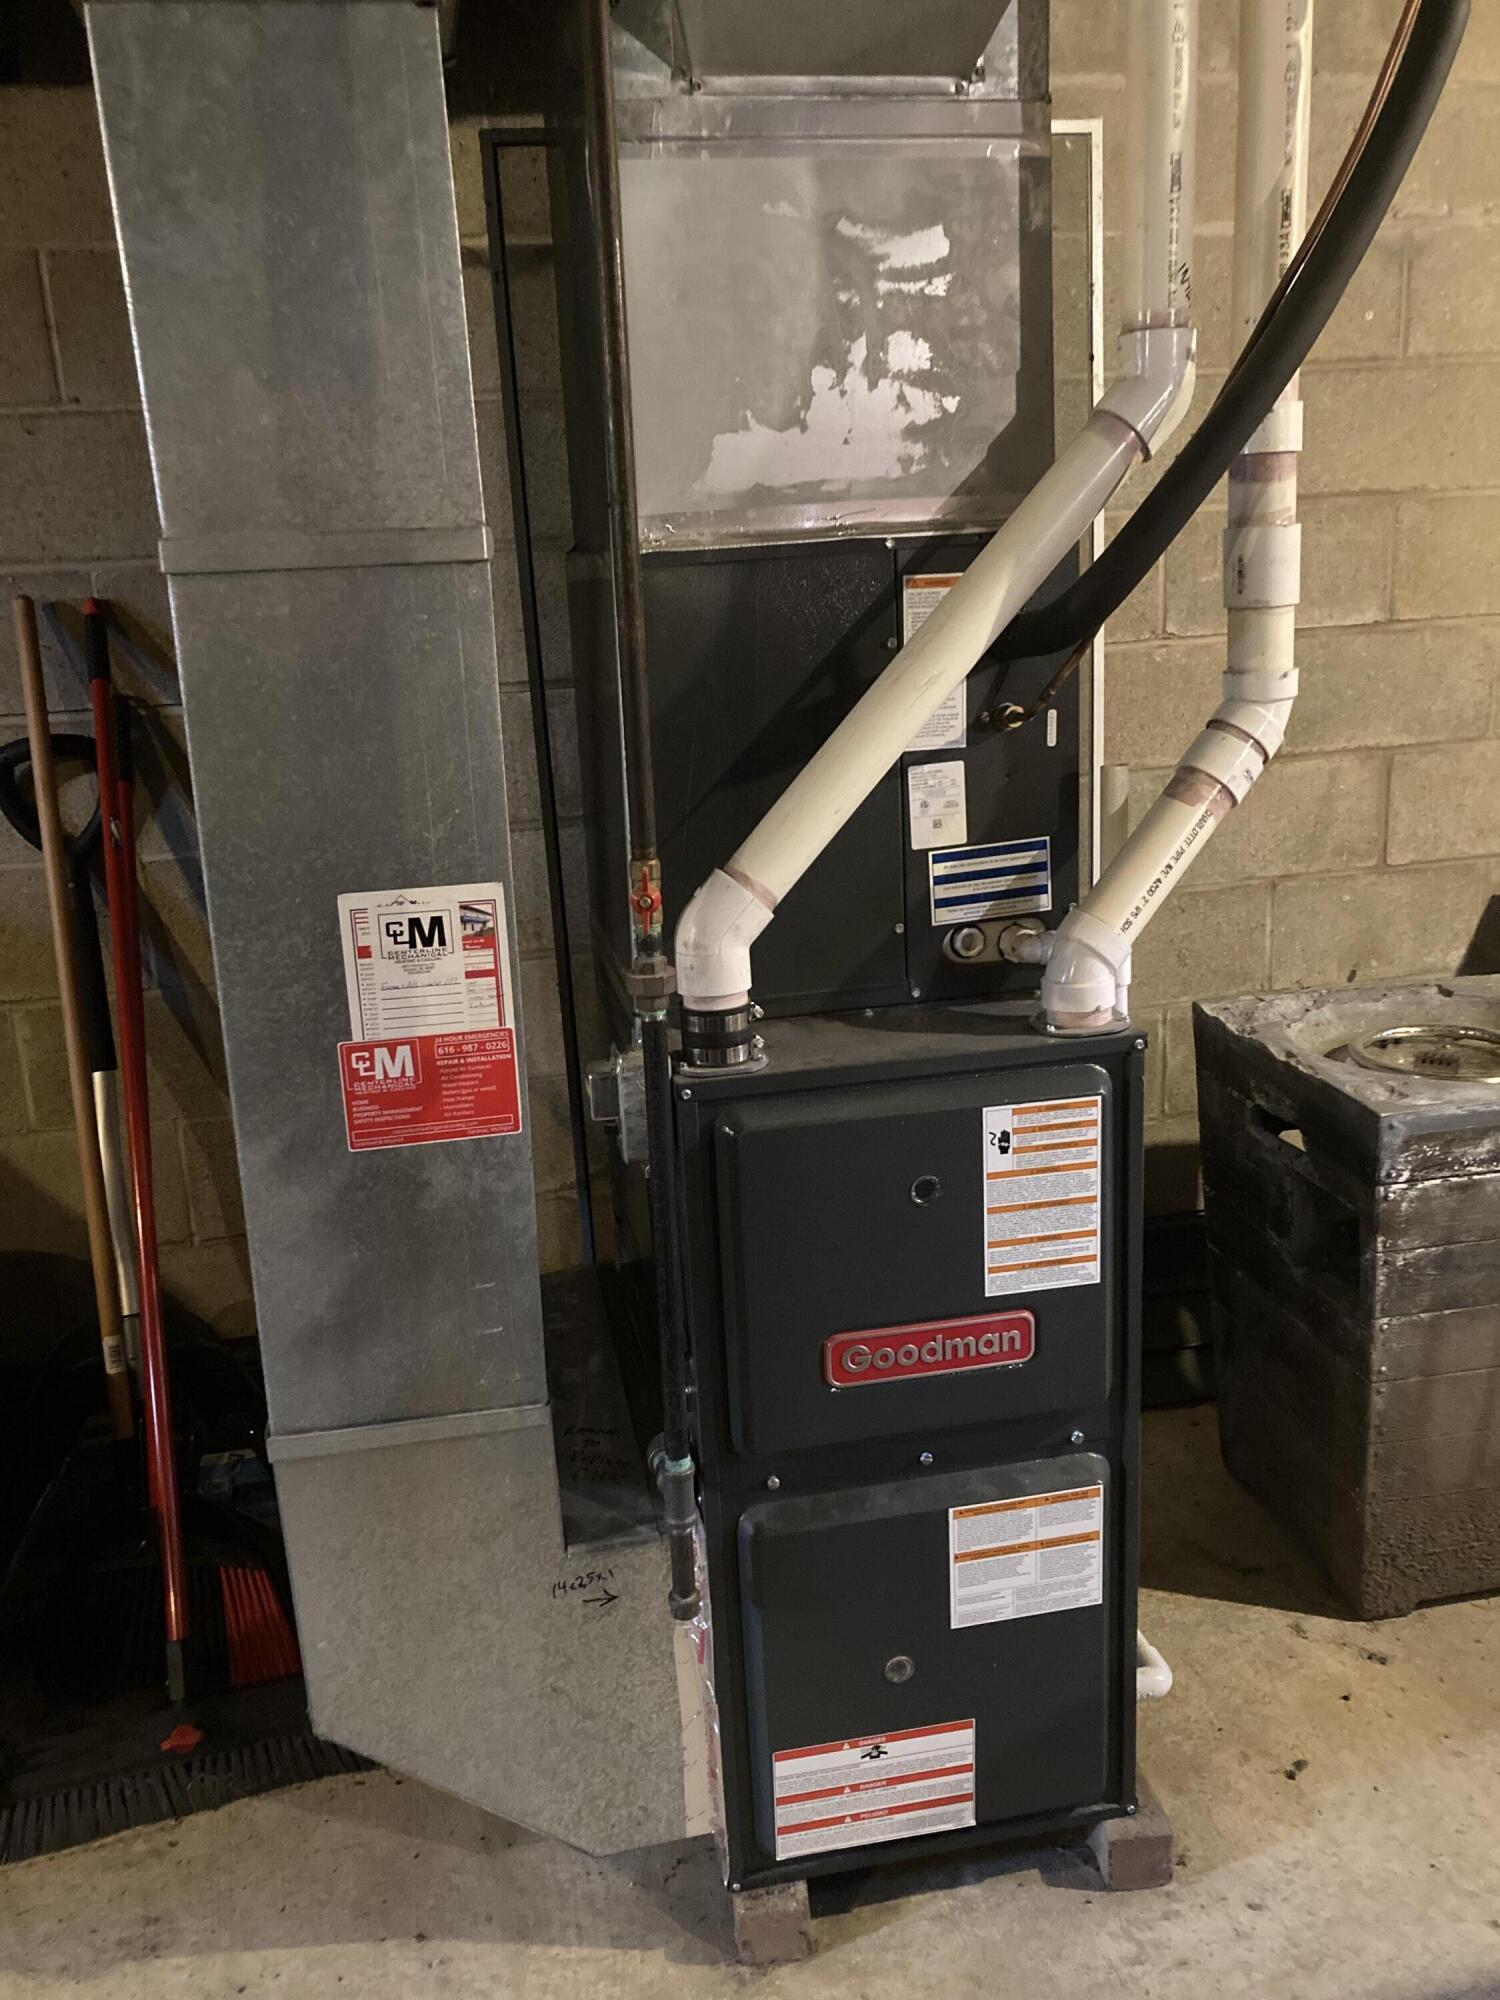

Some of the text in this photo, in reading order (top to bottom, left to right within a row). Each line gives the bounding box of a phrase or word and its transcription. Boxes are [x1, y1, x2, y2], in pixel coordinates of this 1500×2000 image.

[1183, 809, 1213, 848] CHARLOTTE
[1171, 846, 1186, 864] PIPE
[1147, 878, 1163, 898] 4200
[388, 952, 448, 961] MECHANICAL
[464, 1031, 509, 1040] EMERGENCIES
[438, 1045, 455, 1055] 616
[462, 1043, 478, 1052] 987
[485, 1041, 507, 1050] 0226
[466, 1053, 512, 1063] INSTALLATION
[841, 1329, 1031, 1374] Goodman
